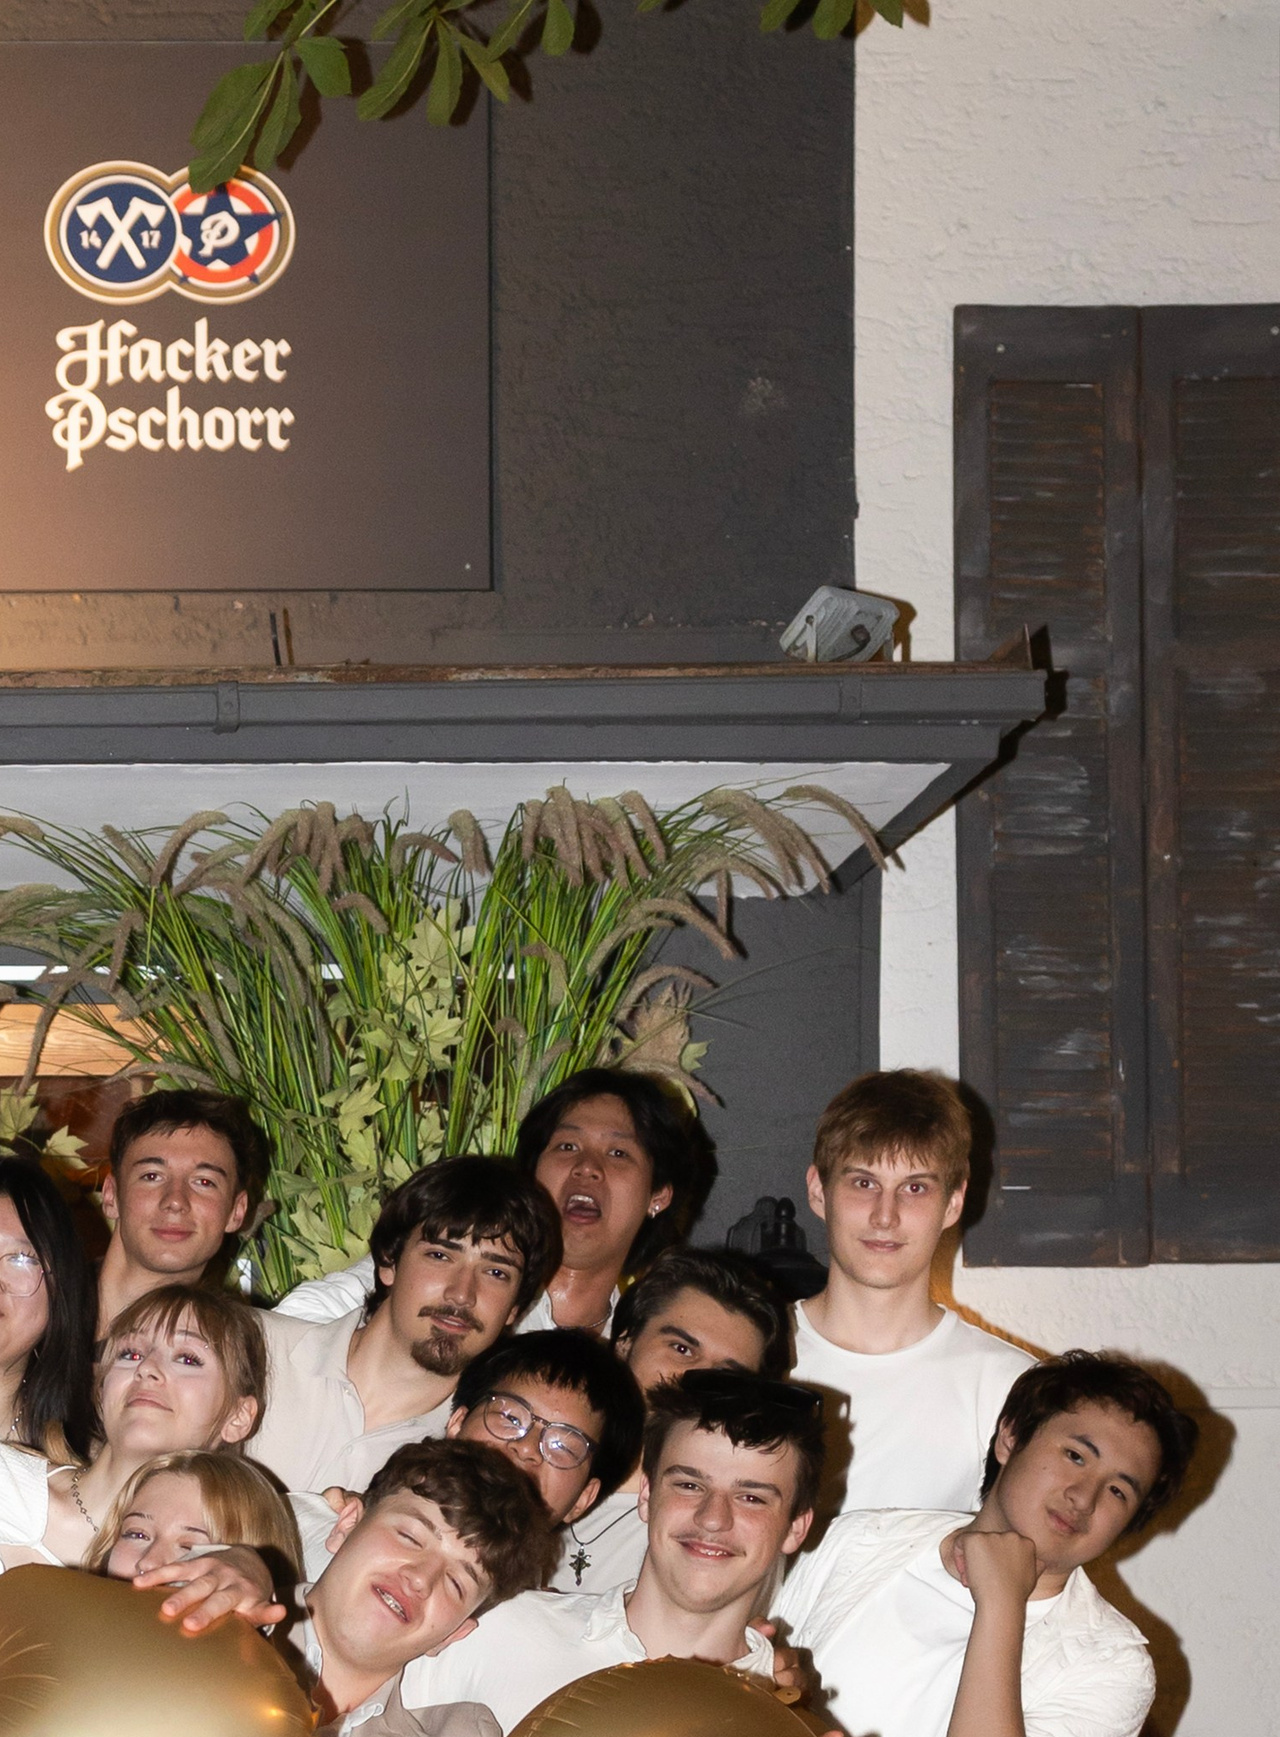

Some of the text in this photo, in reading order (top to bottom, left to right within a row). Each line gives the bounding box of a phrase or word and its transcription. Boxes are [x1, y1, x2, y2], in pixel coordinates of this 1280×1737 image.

[80, 229, 162, 249] 14 17
[55, 317, 292, 392] Hacker
[45, 385, 295, 472] Pschorr
